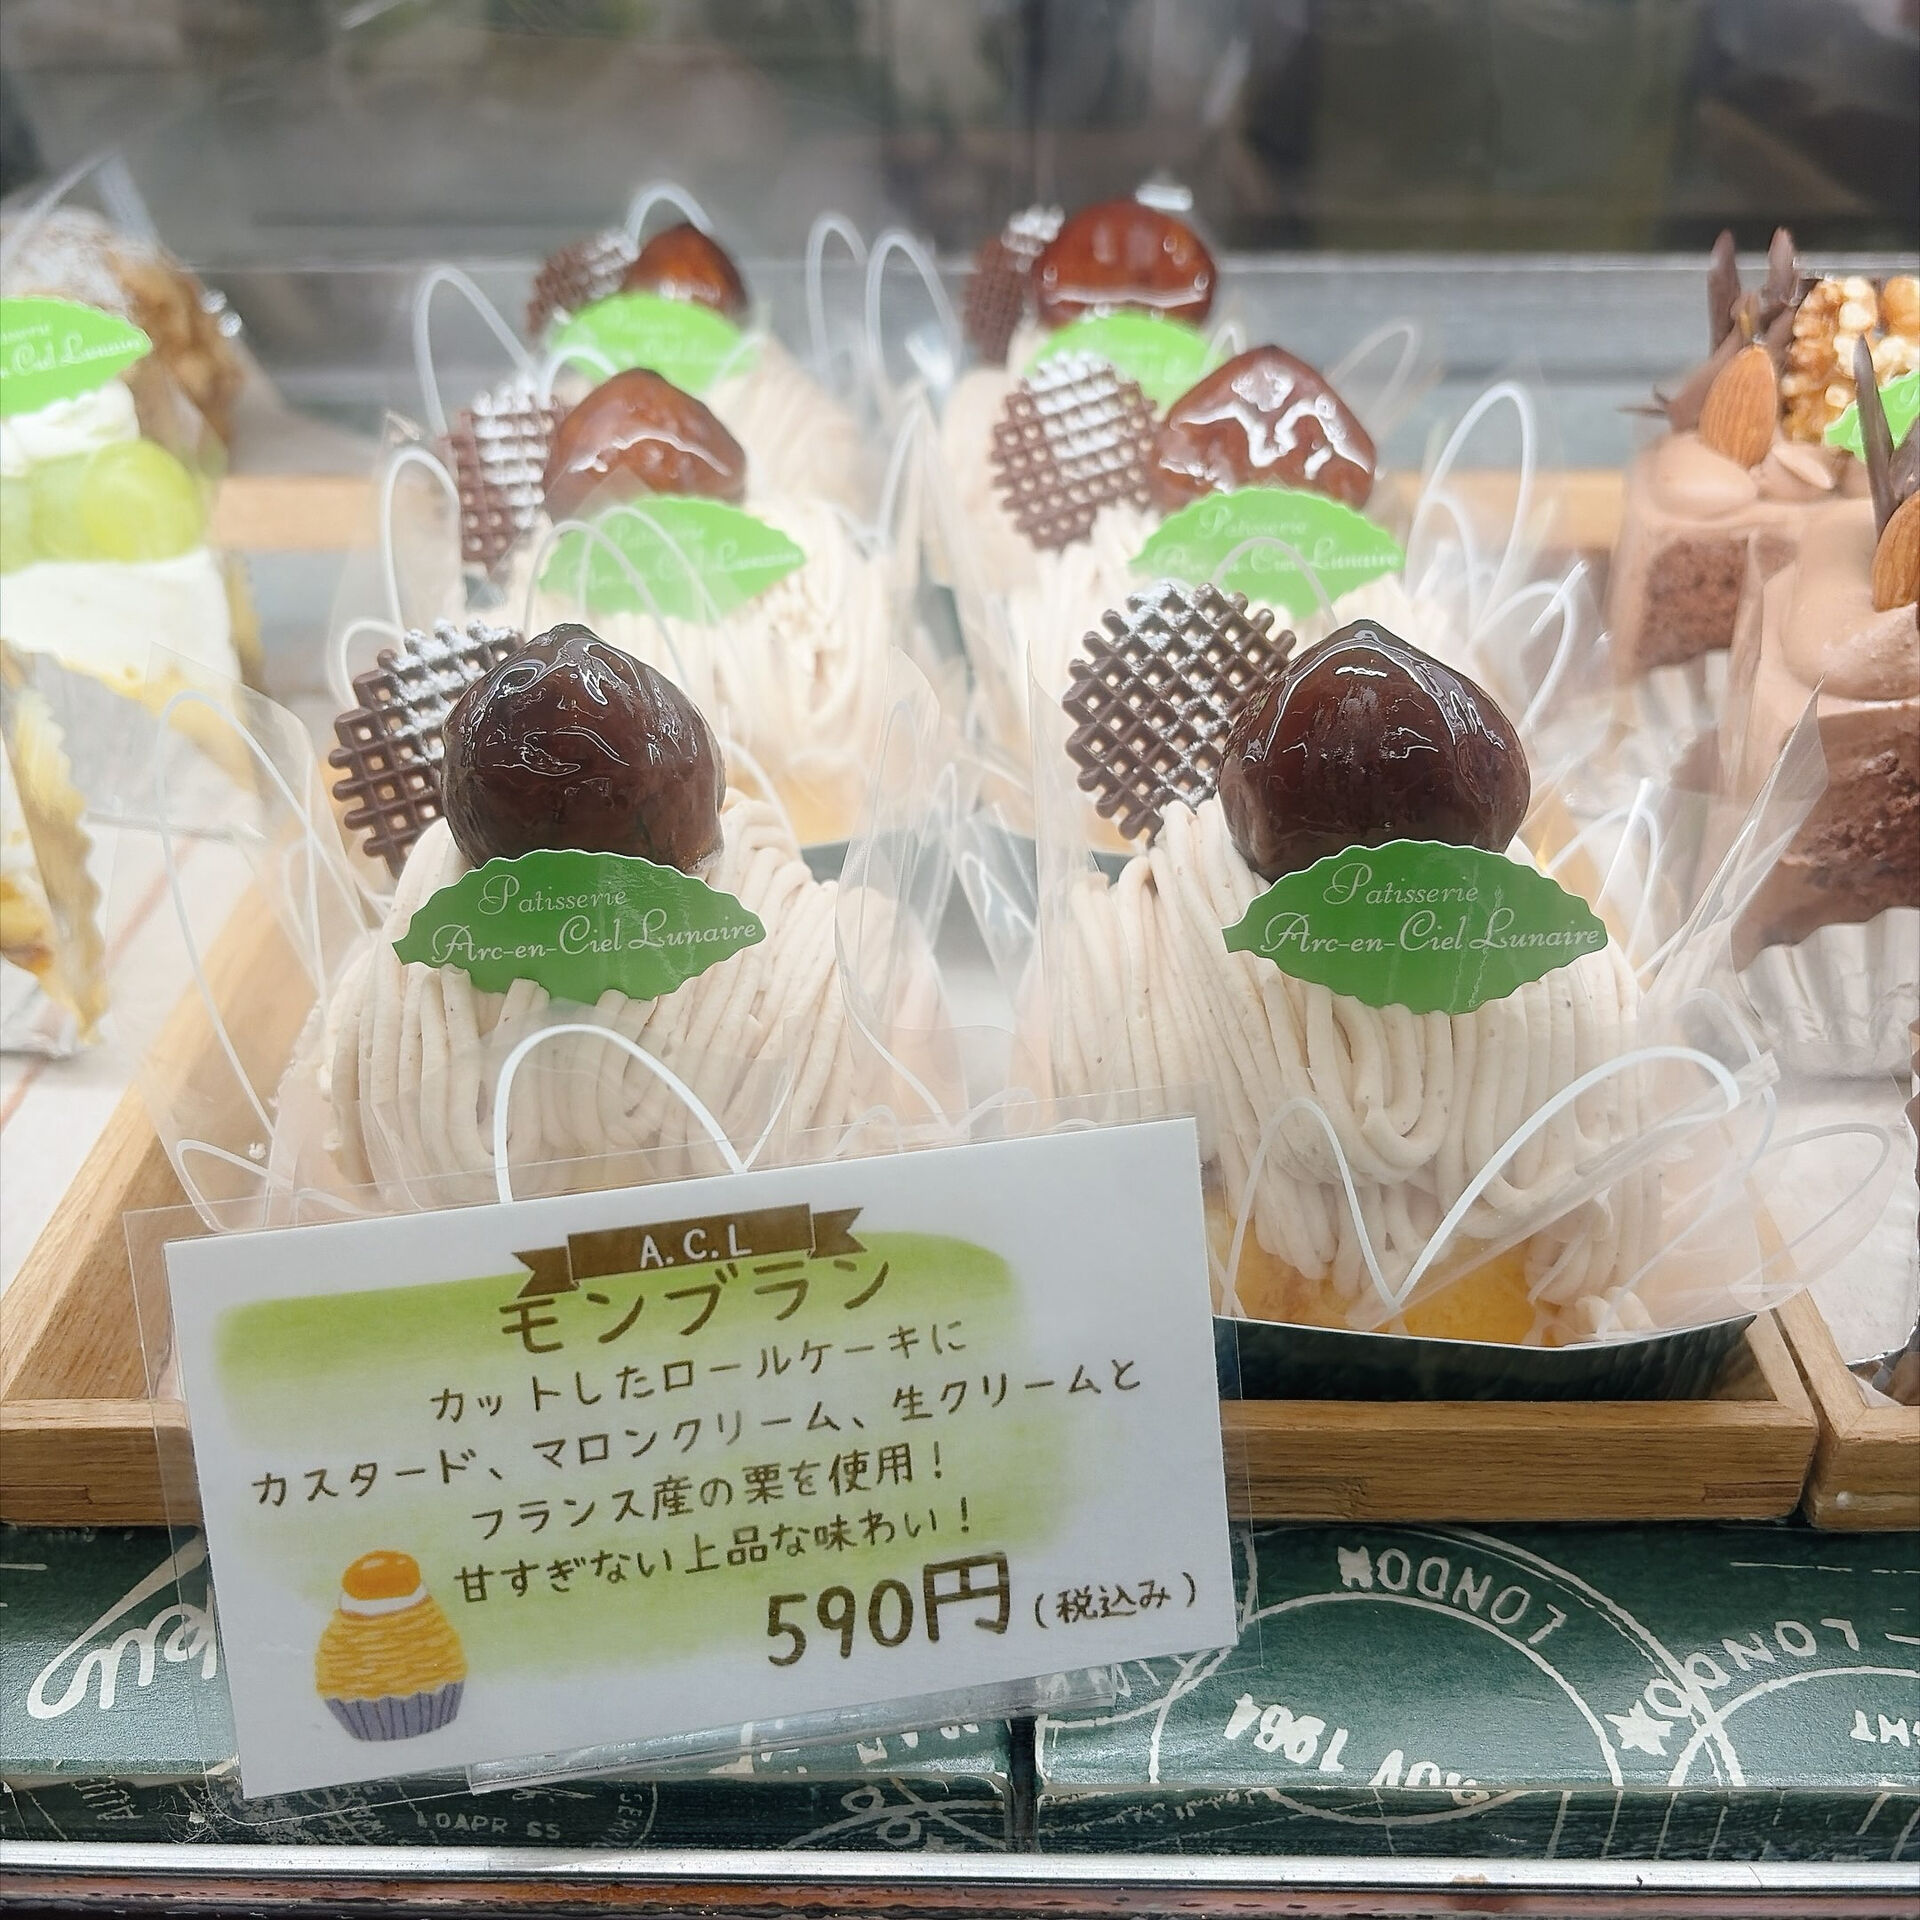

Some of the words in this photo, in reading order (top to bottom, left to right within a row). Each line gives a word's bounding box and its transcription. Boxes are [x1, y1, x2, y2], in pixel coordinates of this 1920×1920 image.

[477, 873, 629, 916] Patisserie
[1259, 909, 1468, 954] Arc-en-Ciel
[1469, 906, 1600, 950] Lunaire
[1322, 861, 1479, 906] Patisserie
[431, 914, 623, 965] Arc-en-Ciel
[627, 907, 757, 951] Lunaire
[640, 1224, 753, 1270] A.C.L
[500, 1260, 890, 1355] モンブラン
[431, 1321, 967, 1422] カットしたロールケーキに
[252, 1358, 1142, 1506] カスタード、マロンクリーム、生クリームと
[472, 1441, 944, 1540] フランス産の栗を使用！
[454, 1497, 970, 1602] 甘すぎない上品な味わい！
[768, 1551, 1011, 1667] 590円
